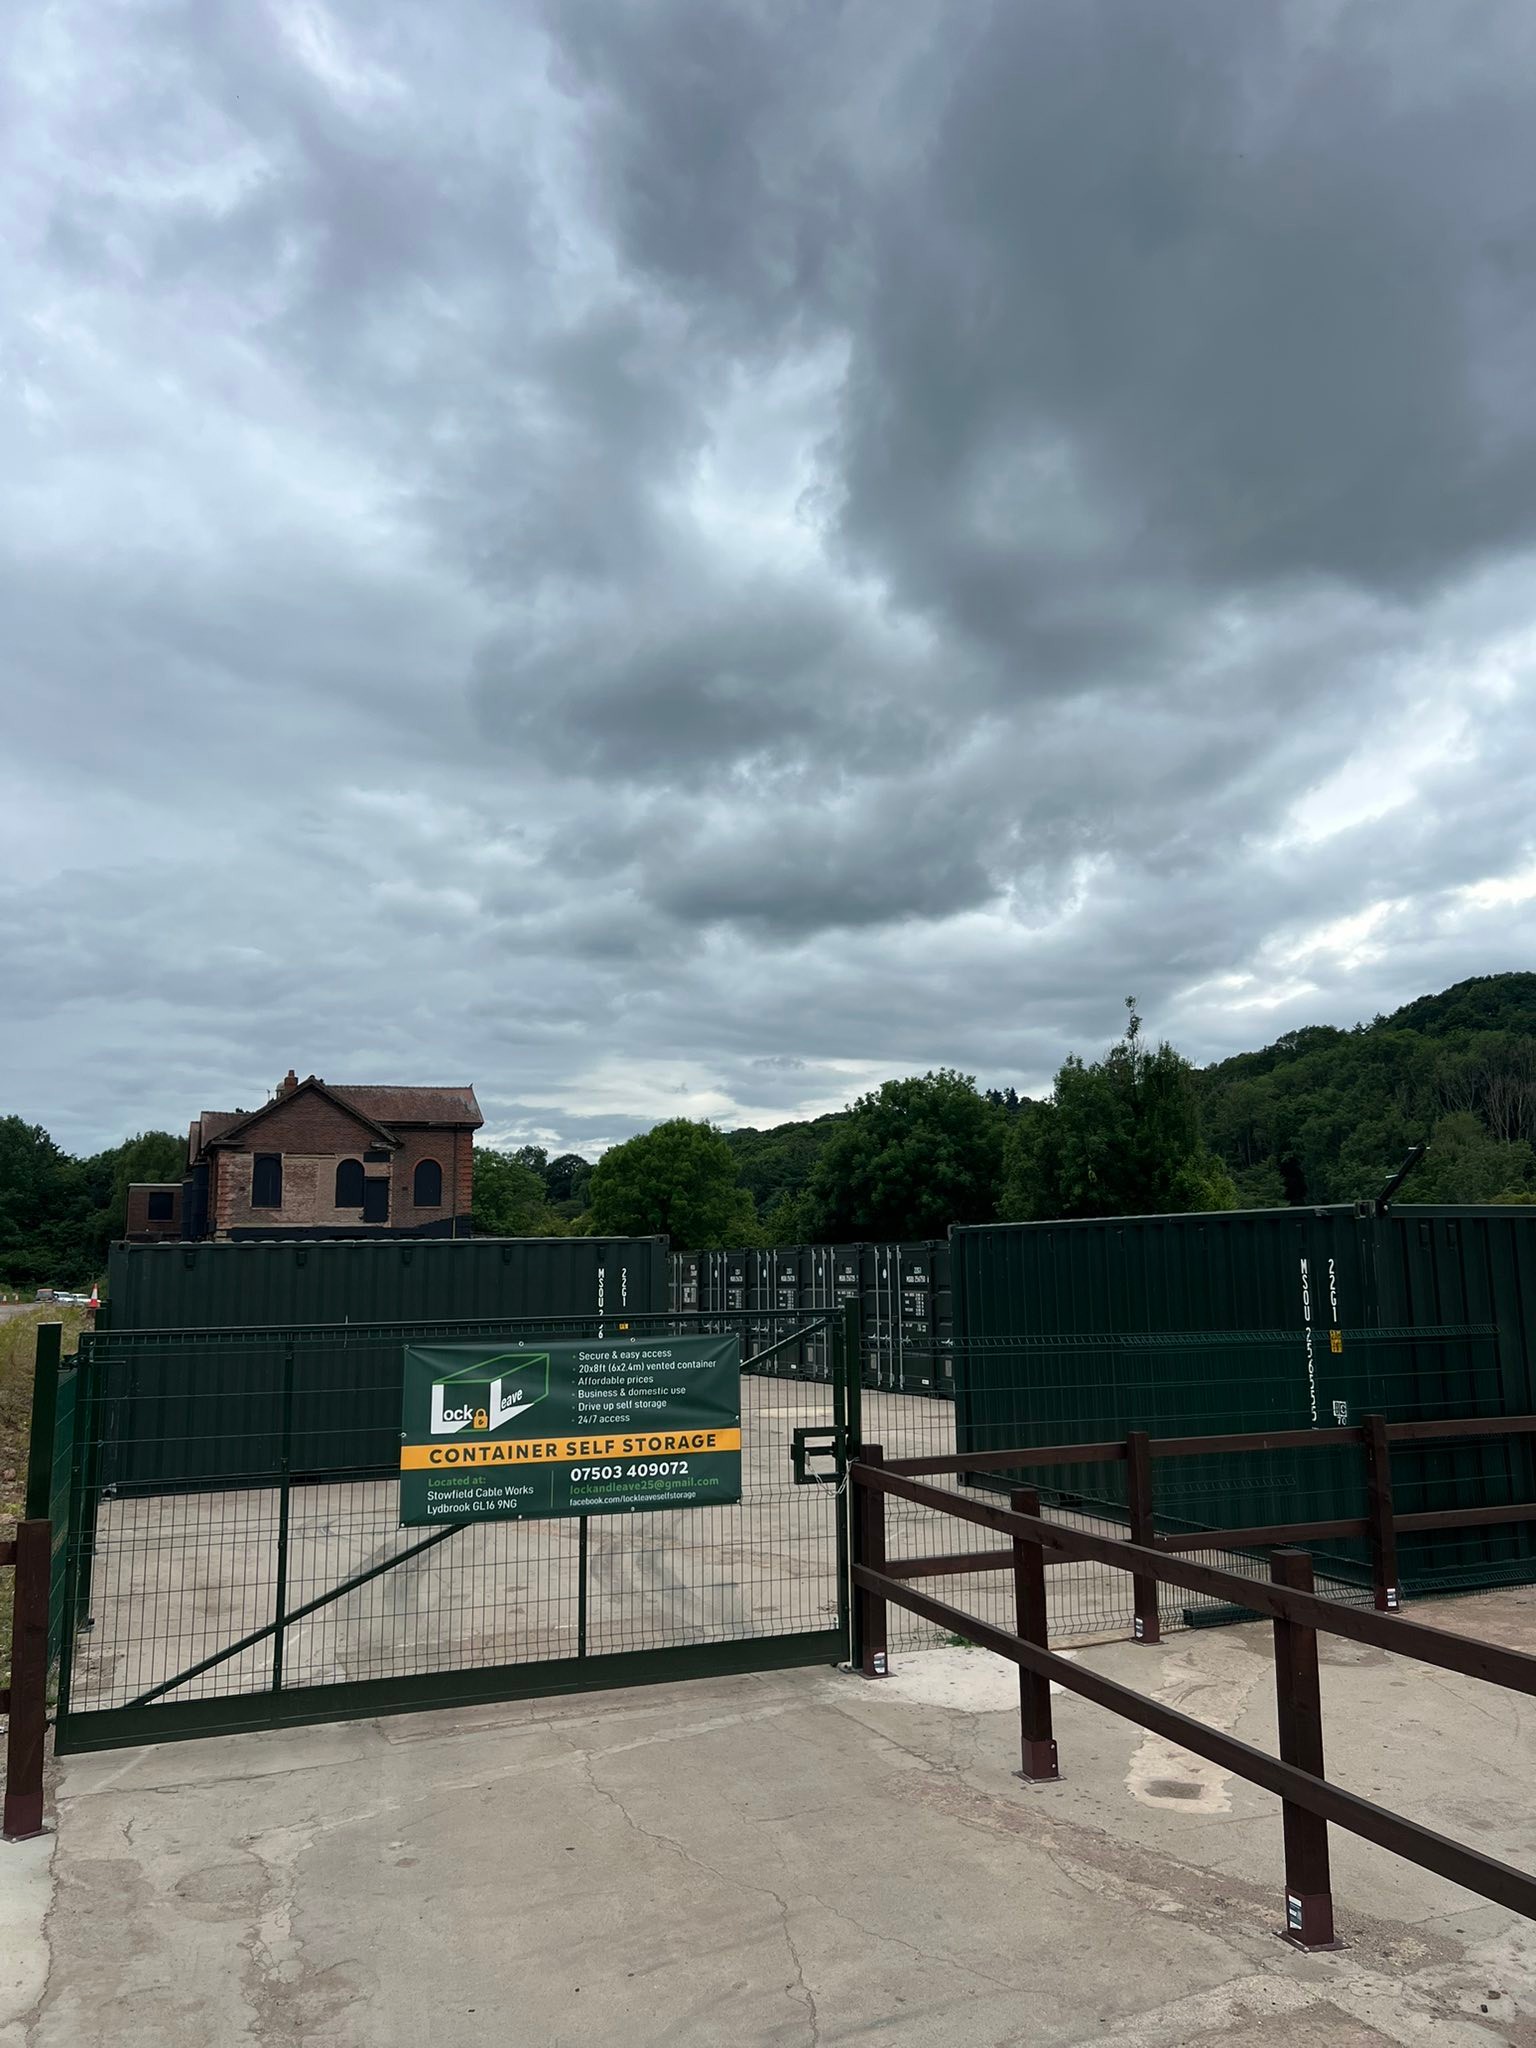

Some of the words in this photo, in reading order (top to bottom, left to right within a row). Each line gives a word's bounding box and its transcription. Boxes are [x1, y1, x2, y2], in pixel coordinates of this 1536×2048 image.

[1300, 1258, 1311, 1322] MSOU
[1328, 1258, 1338, 1322] 22G1
[578, 1352, 610, 1360] Secure
[612, 1351, 618, 1360] &
[620, 1352, 640, 1360] easy
[642, 1350, 672, 1358] access
[578, 1364, 606, 1373] 20x8ft
[608, 1362, 644, 1373] (6x2.4m)
[646, 1362, 676, 1370] vented
[677, 1360, 717, 1370] container
[578, 1376, 625, 1386] Affordable
[627, 1376, 654, 1386] prices
[578, 1389, 618, 1398] Business
[620, 1388, 626, 1397] &
[628, 1387, 668, 1396] domestic
[670, 1386, 686, 1395] use
[430, 1384, 474, 1434] Lock
[488, 1378, 535, 1432] Leave
[578, 1402, 600, 1412] Drive
[602, 1402, 614, 1412] up
[616, 1401, 632, 1410] self
[634, 1400, 667, 1410] storage
[578, 1415, 597, 1424] 24/7
[600, 1414, 630, 1424] access
[429, 1443, 558, 1464] CONTAINER
[566, 1440, 615, 1456] SELF
[622, 1434, 716, 1452] STORAGE
[570, 1465, 622, 1482] 07503
[626, 1460, 689, 1478] 409072
[428, 1476, 470, 1488] Located
[472, 1476, 486, 1485] at:
[570, 1476, 720, 1495] lockandleave25@gmail.com
[427, 1488, 474, 1500] Stowfield
[475, 1487, 502, 1498] Cable
[504, 1486, 534, 1496] Works
[569, 1490, 696, 1506] facebook.com/lockleaveselfstorage
[427, 1502, 470, 1516] Lydbrook
[472, 1500, 496, 1511] GL16
[497, 1498, 518, 1510] 9NG
